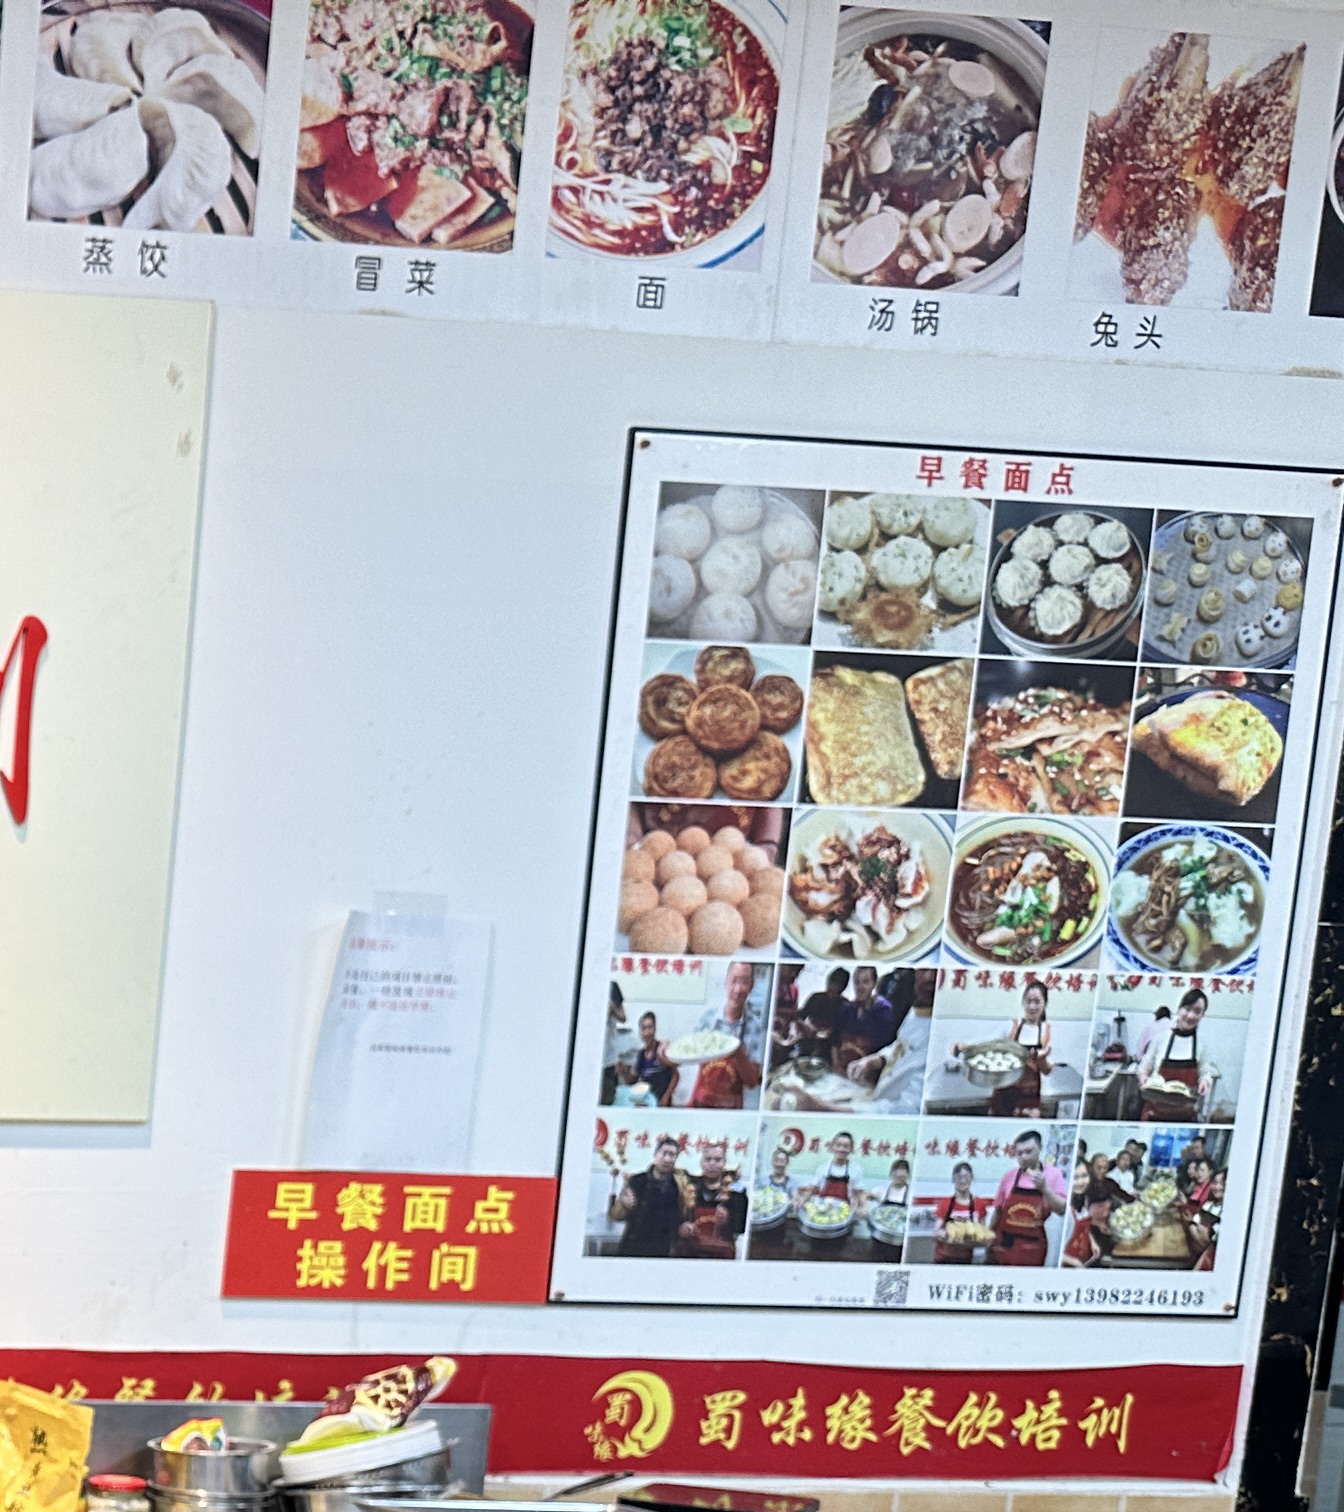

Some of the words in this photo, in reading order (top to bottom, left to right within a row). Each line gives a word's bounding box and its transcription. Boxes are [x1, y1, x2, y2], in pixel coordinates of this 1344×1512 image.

[82, 236, 169, 279] 蒸饺
[354, 255, 438, 297] 冒菜
[635, 275, 667, 311] 面
[867, 297, 941, 337] 汤锅
[1090, 311, 1164, 350] 兔头
[914, 454, 1076, 497] 早餐面点
[267, 1181, 516, 1235] 早餐面点
[295, 1238, 480, 1291] 操作间
[696, 1386, 1136, 1456] 蜀味缘餐饮培训
